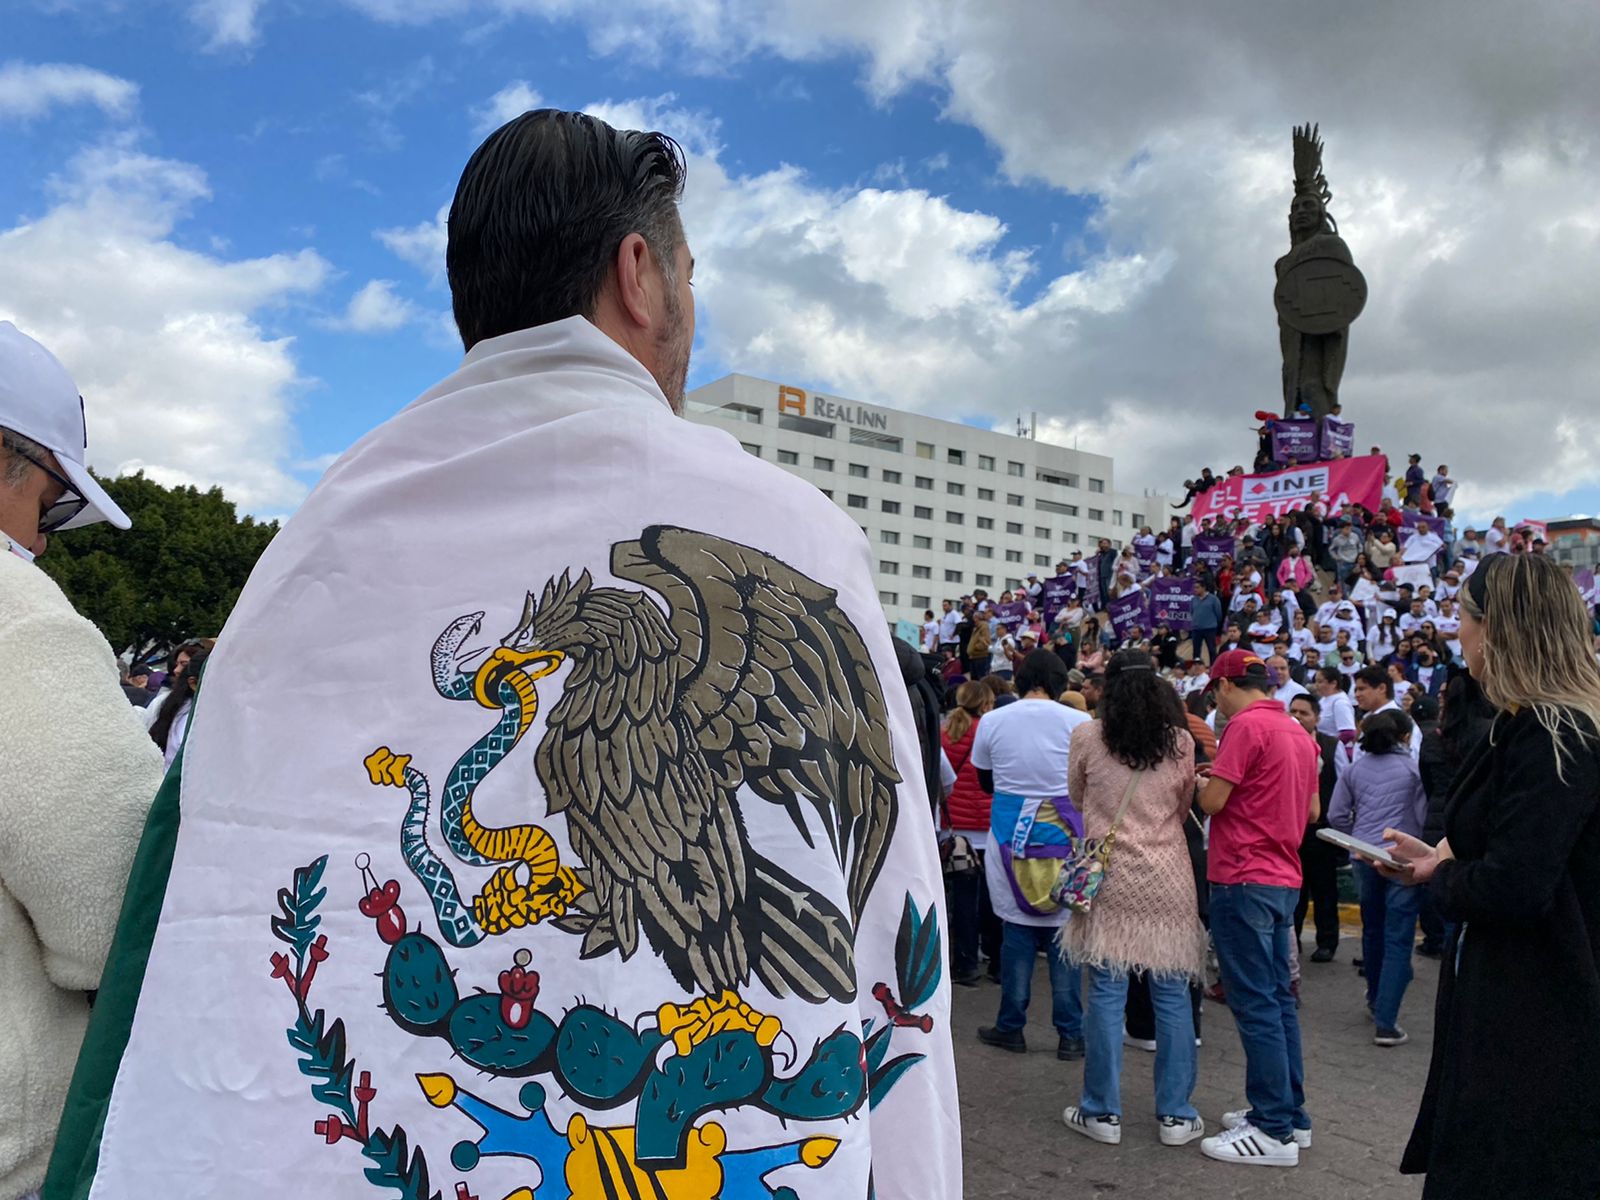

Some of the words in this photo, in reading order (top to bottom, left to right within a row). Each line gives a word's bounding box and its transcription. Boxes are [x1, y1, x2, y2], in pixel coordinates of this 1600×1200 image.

[1209, 486, 1237, 509] EL
[1272, 474, 1326, 493] INE
[1197, 551, 1230, 559] DEFIEN
[1122, 604, 1132, 612] YO
[1125, 619, 1135, 627] AL
